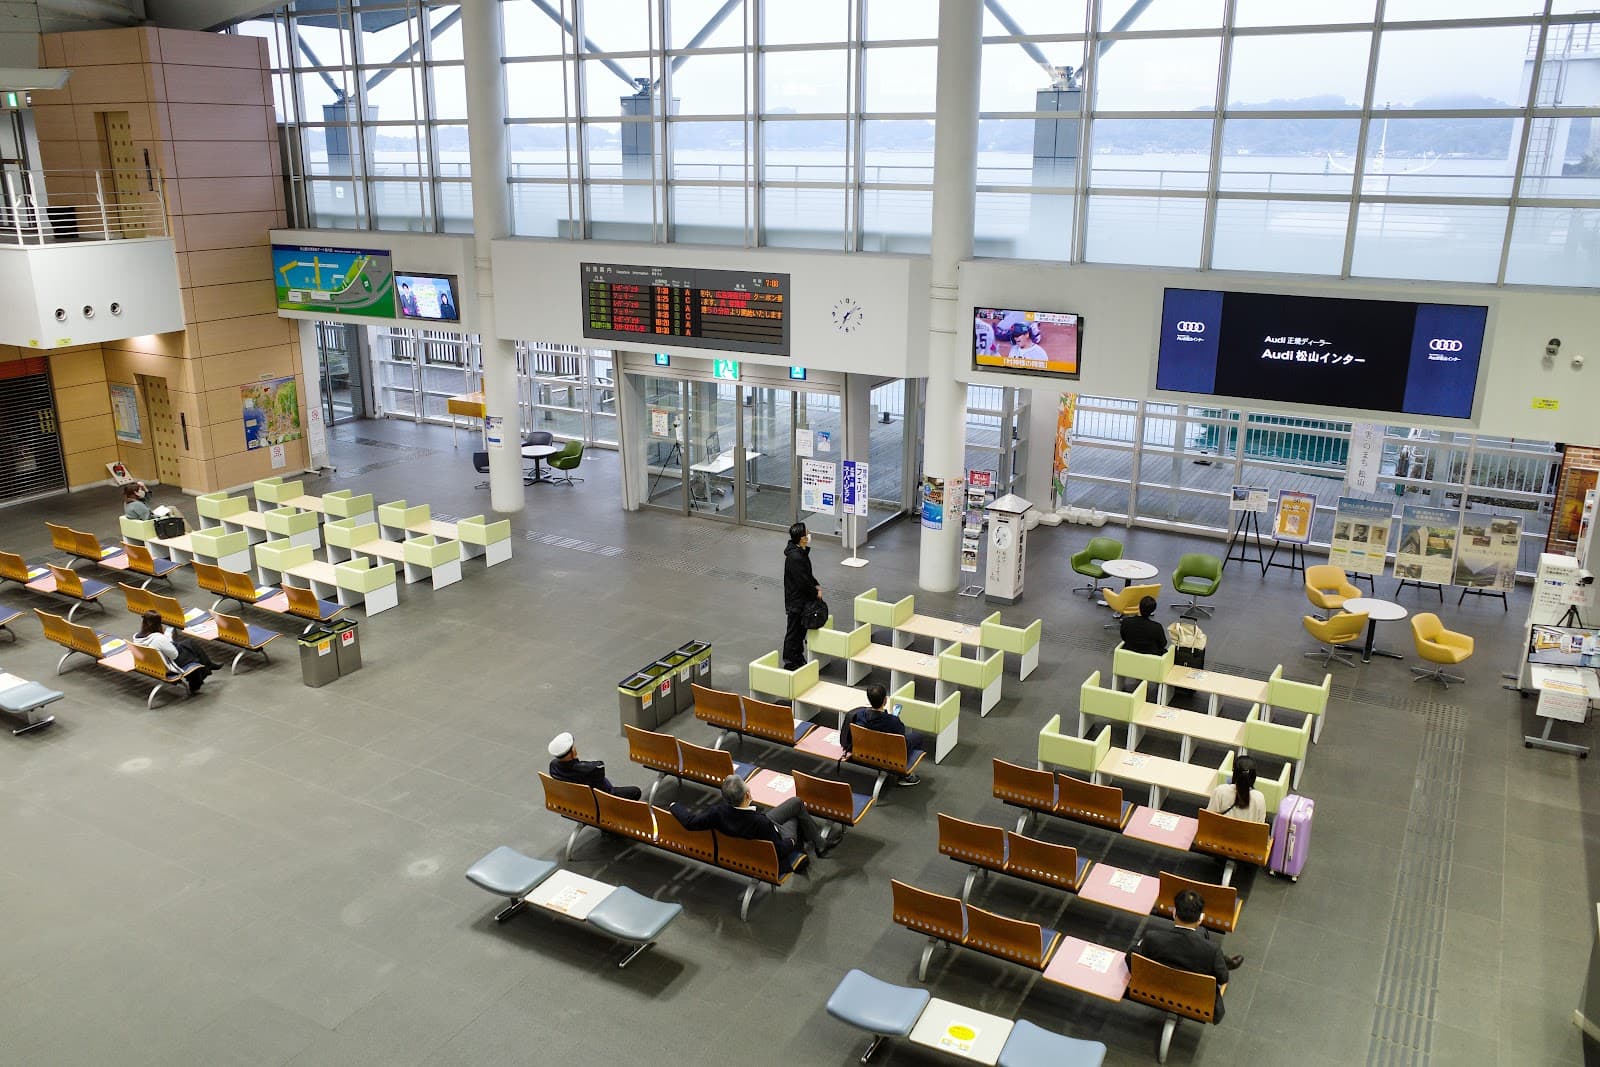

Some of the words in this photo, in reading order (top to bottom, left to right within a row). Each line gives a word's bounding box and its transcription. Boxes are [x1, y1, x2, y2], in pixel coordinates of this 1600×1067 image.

[1264, 336, 1286, 344] Audi
[1287, 336, 1332, 347] 正規ディーラー
[1261, 348, 1294, 361] Audi
[1296, 350, 1366, 365] 松山インター
